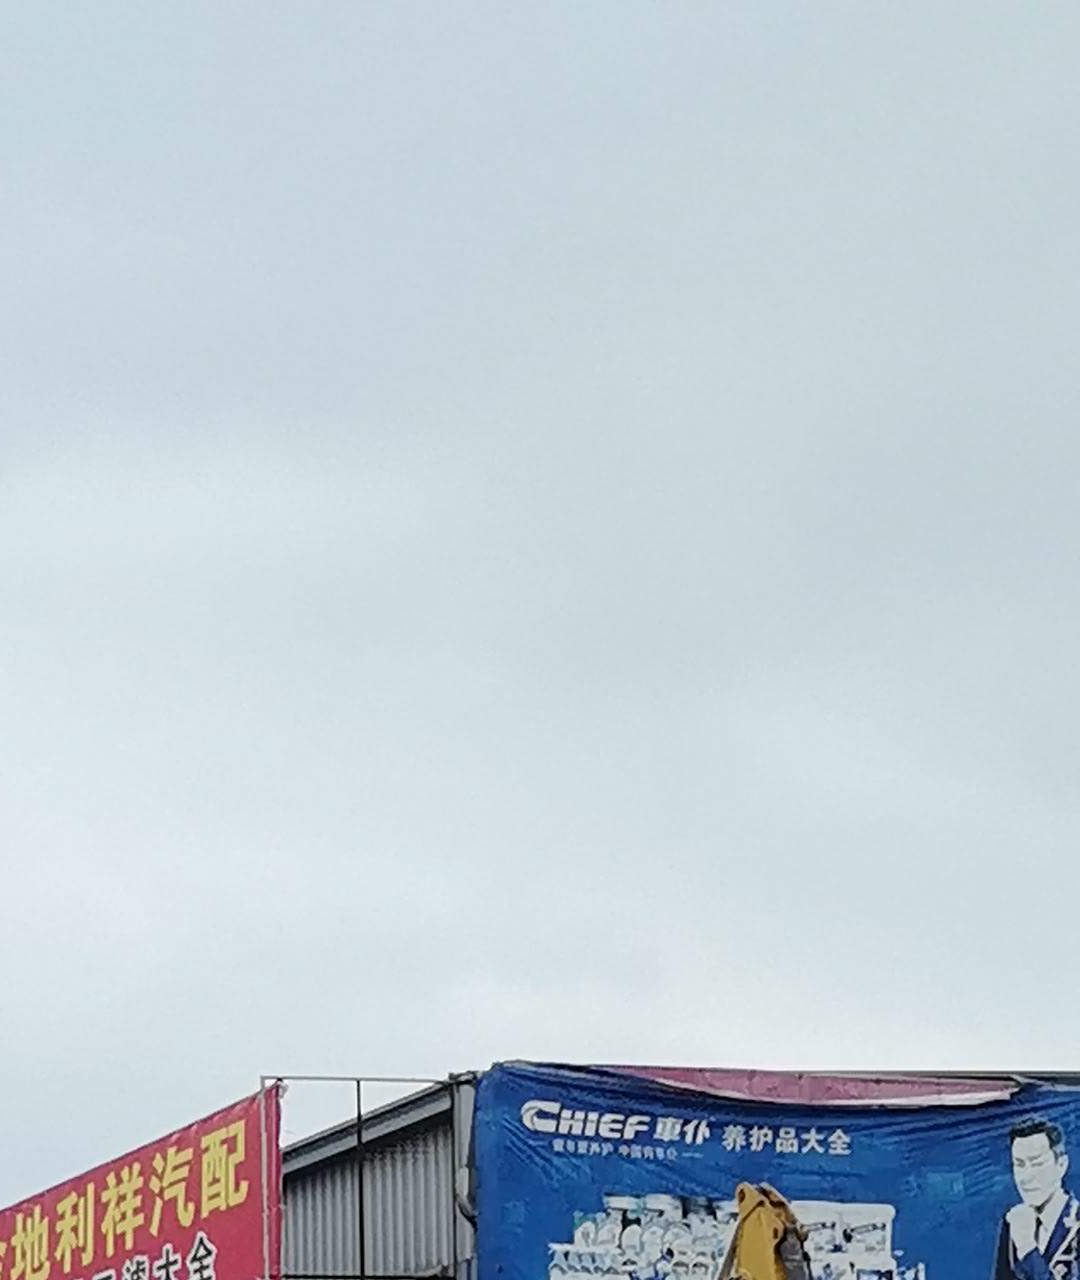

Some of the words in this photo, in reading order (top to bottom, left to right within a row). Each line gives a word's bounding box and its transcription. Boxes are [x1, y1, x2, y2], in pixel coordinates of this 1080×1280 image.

[521, 1100, 651, 1140] CHIEF
[721, 1124, 852, 1155] 养护品大全
